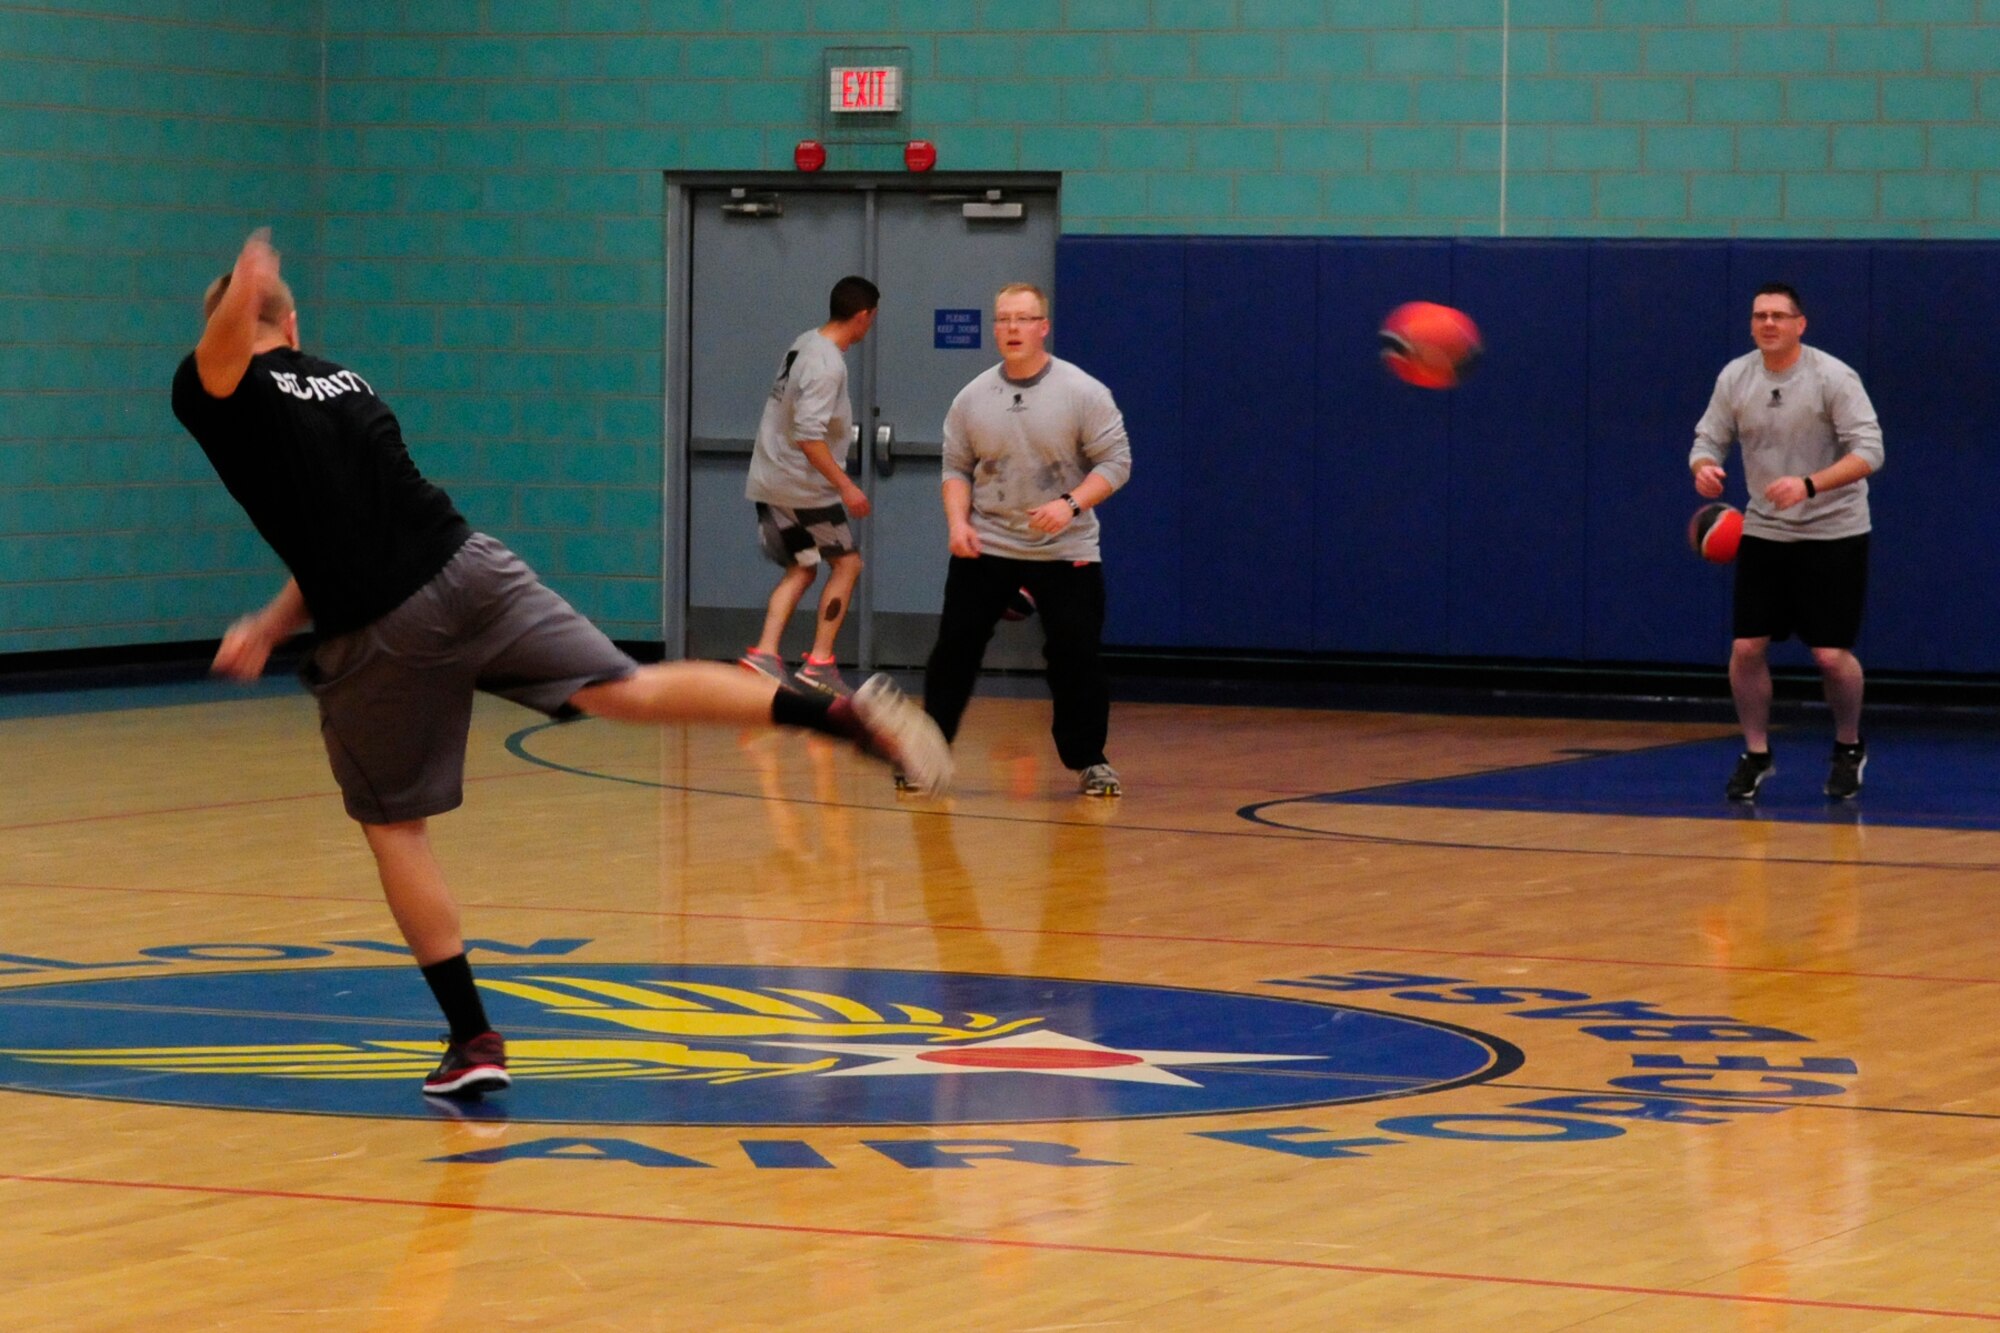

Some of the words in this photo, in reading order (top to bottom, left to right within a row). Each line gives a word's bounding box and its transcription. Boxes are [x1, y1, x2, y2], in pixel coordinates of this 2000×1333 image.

[842, 70, 888, 108] EXIT
[1256, 970, 1818, 1042] BASE
[1187, 1052, 1858, 1160] FORCE
[421, 1137, 1134, 1169] AIR
